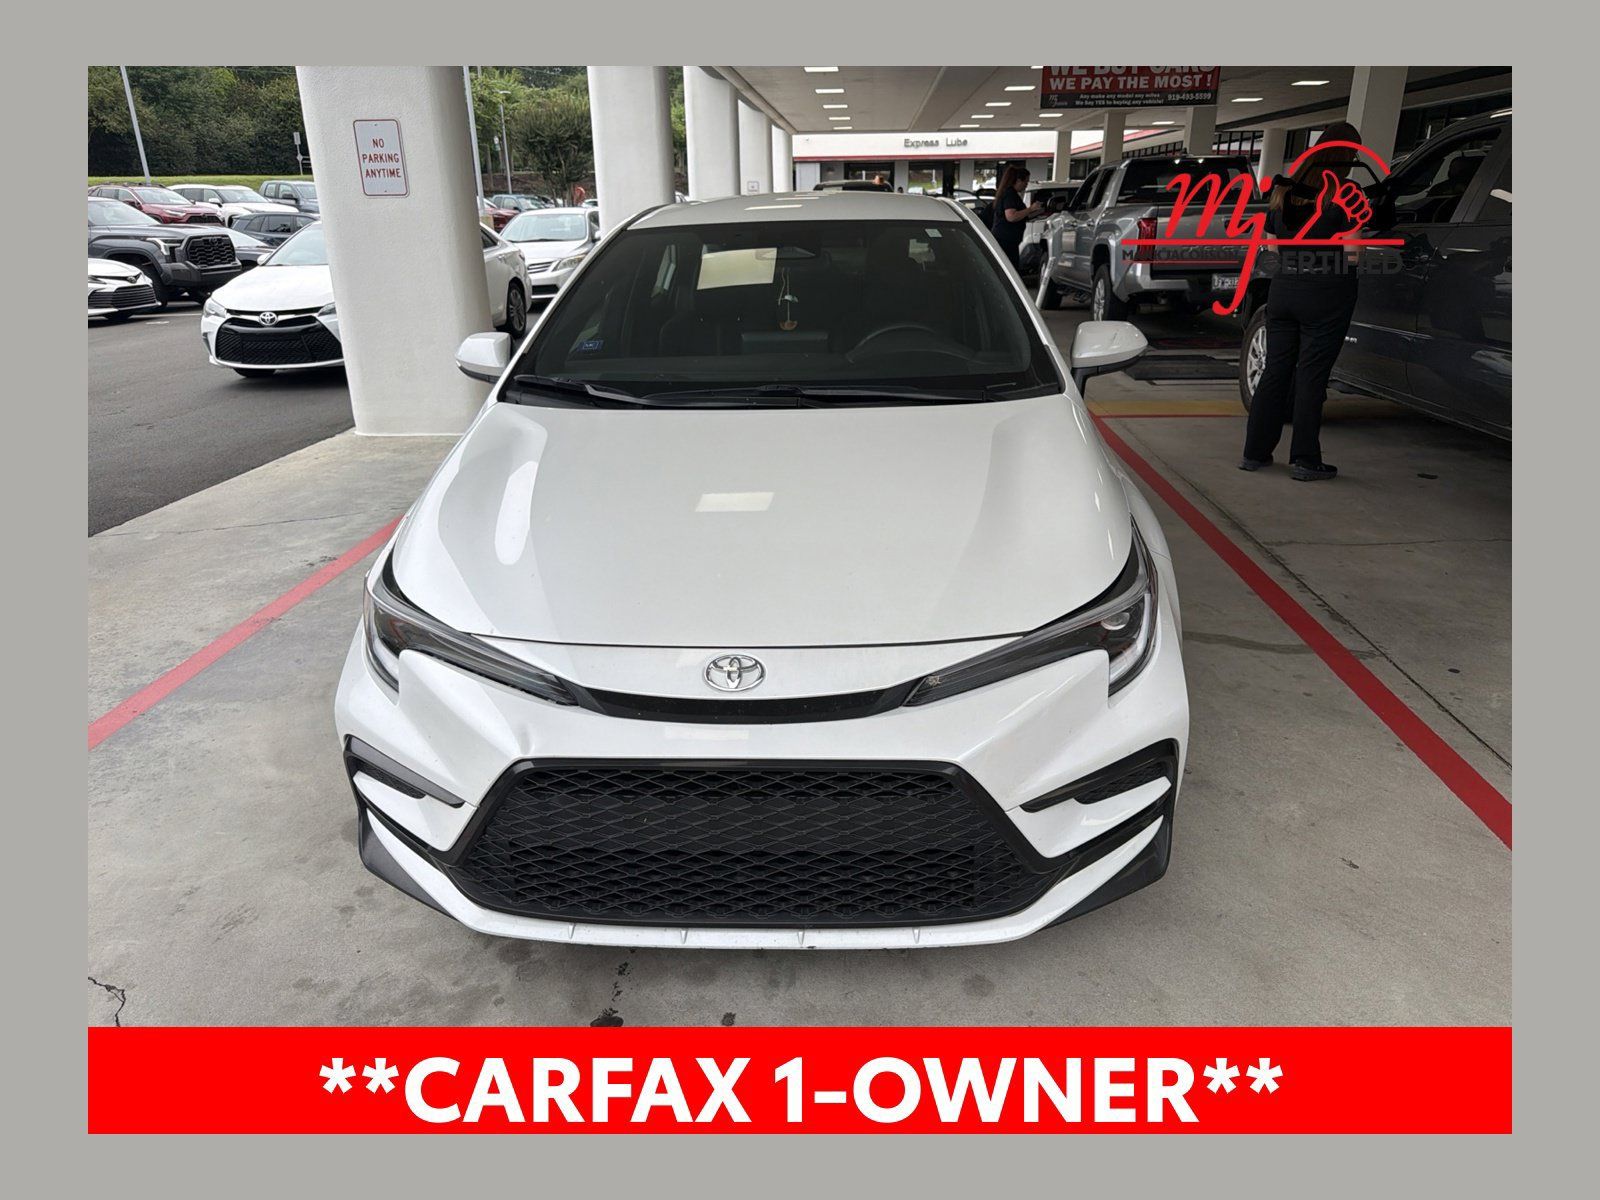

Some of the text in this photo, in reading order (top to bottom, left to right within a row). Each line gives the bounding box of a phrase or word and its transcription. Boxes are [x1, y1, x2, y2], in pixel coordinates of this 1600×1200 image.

[1049, 78, 1076, 90] WE
[1081, 77, 1114, 90] PAY
[1117, 75, 1149, 89] THE
[1154, 74, 1202, 88] MOST
[372, 138, 385, 148] NO
[904, 137, 968, 149] Express Lube
[362, 153, 400, 163] PARKING
[365, 168, 401, 178] ANYTIME
